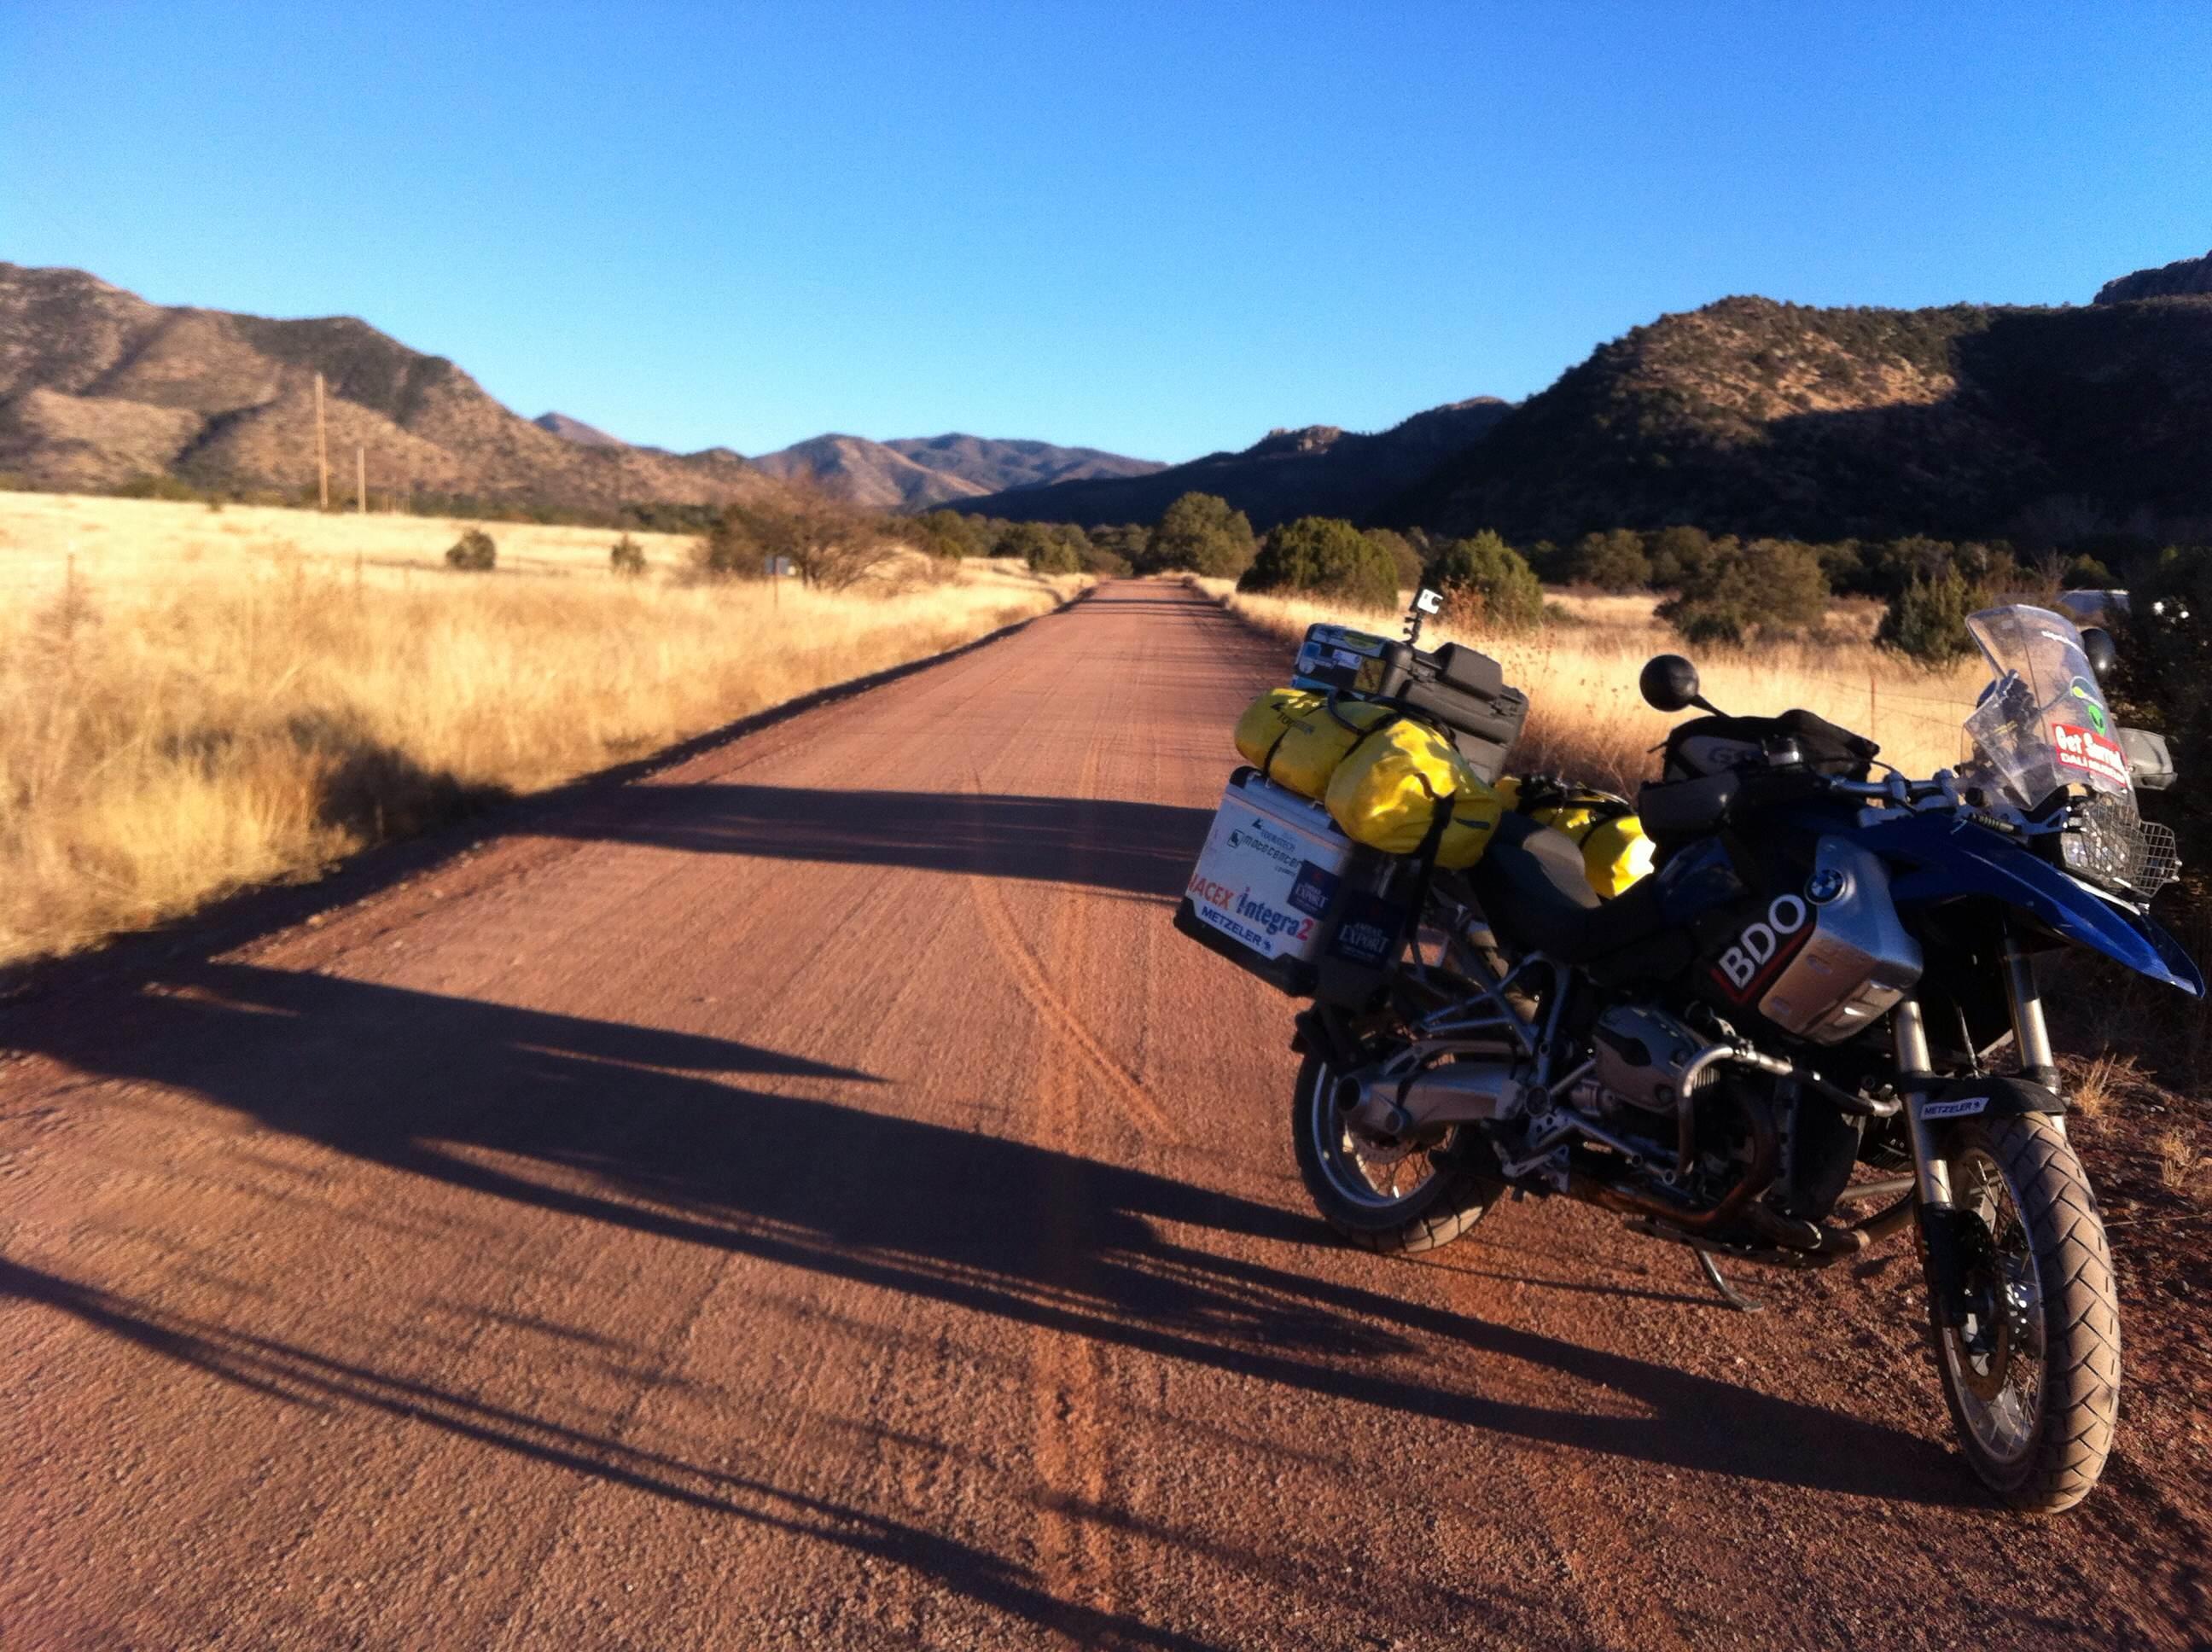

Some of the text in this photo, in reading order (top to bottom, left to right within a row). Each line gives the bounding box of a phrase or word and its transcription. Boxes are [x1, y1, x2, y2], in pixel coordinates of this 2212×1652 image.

[1202, 905, 1262, 946] METZELER
[1719, 894, 1807, 989] BDO
[1924, 1102, 1972, 1114] METZELER
